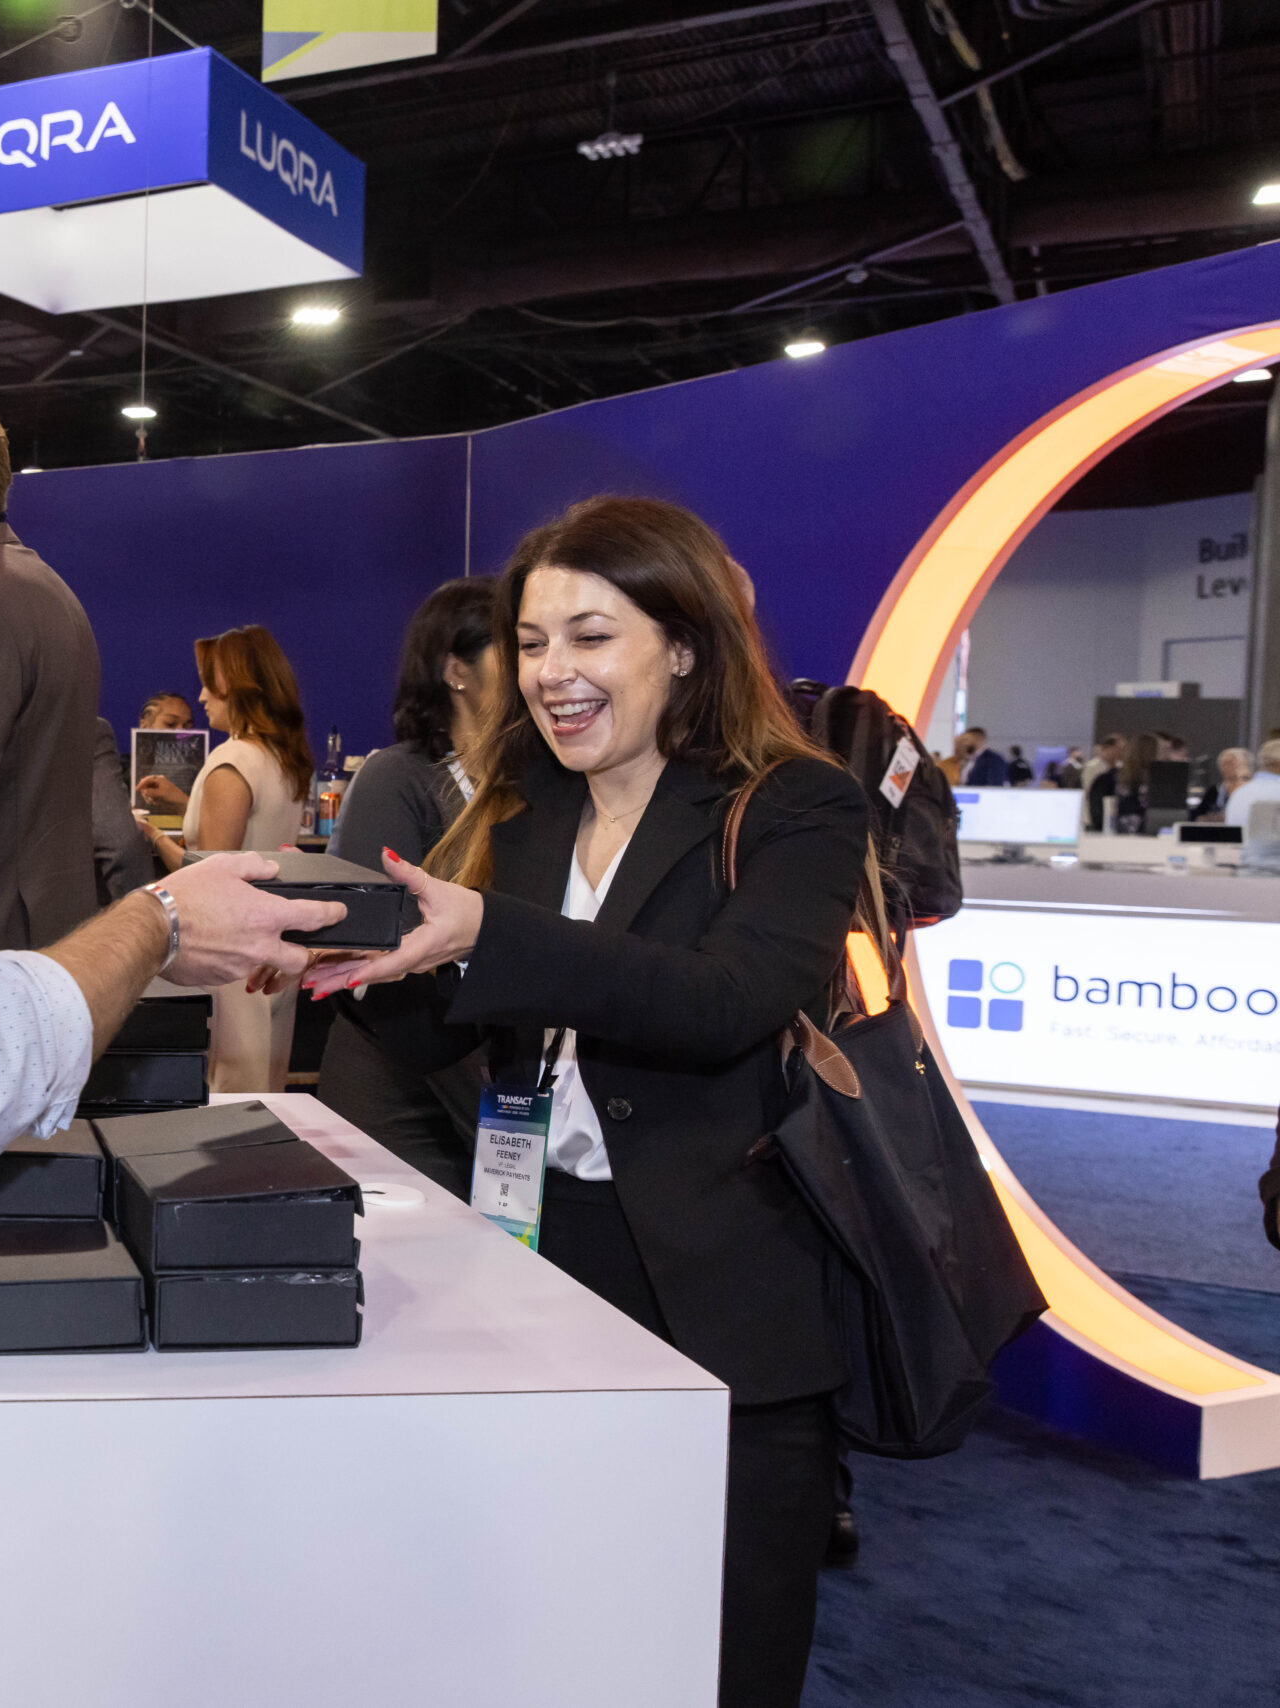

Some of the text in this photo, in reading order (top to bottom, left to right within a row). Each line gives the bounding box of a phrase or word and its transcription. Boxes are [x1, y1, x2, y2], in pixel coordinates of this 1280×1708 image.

[239, 108, 338, 217] LUQRA
[1053, 964, 1278, 1016] bamboo
[497, 1094, 533, 1107] TRANSACT
[490, 1134, 532, 1150] ELISABETH
[496, 1149, 522, 1161] FEENEY
[483, 1167, 531, 1182] MAVERICK PAYMENTS
